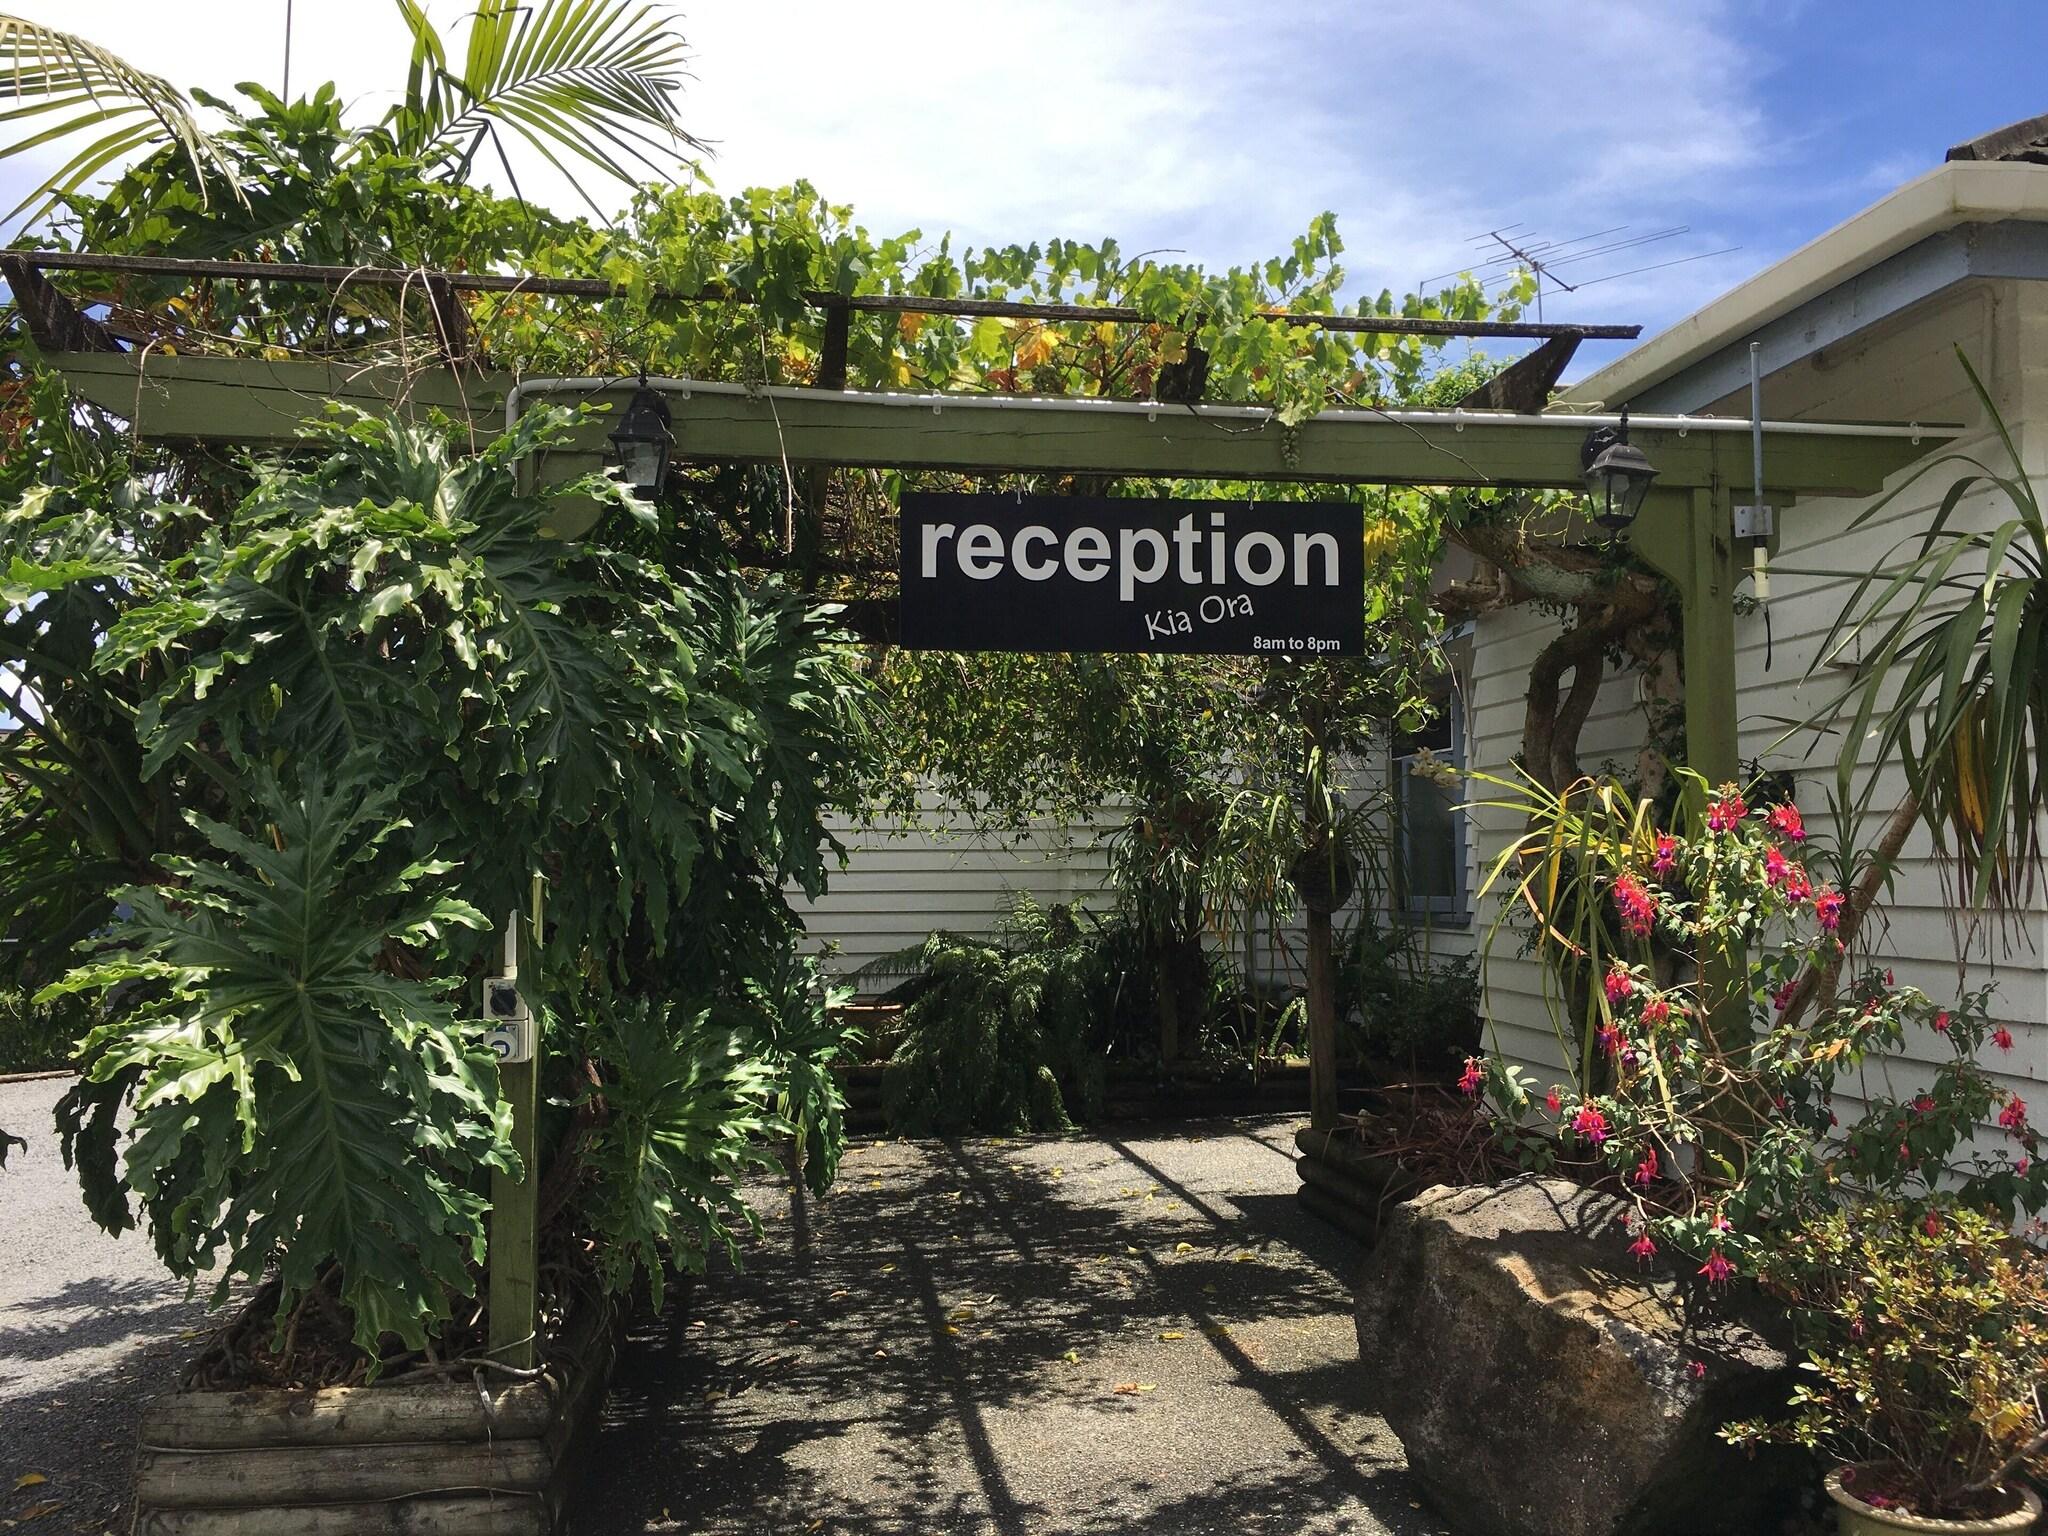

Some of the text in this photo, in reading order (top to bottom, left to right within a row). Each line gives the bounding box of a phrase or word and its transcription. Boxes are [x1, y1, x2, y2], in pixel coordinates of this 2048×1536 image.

[921, 512, 1340, 602] reception
[1144, 593, 1255, 641] Kia Ora
[1253, 635, 1341, 654] 8am to 8pm
